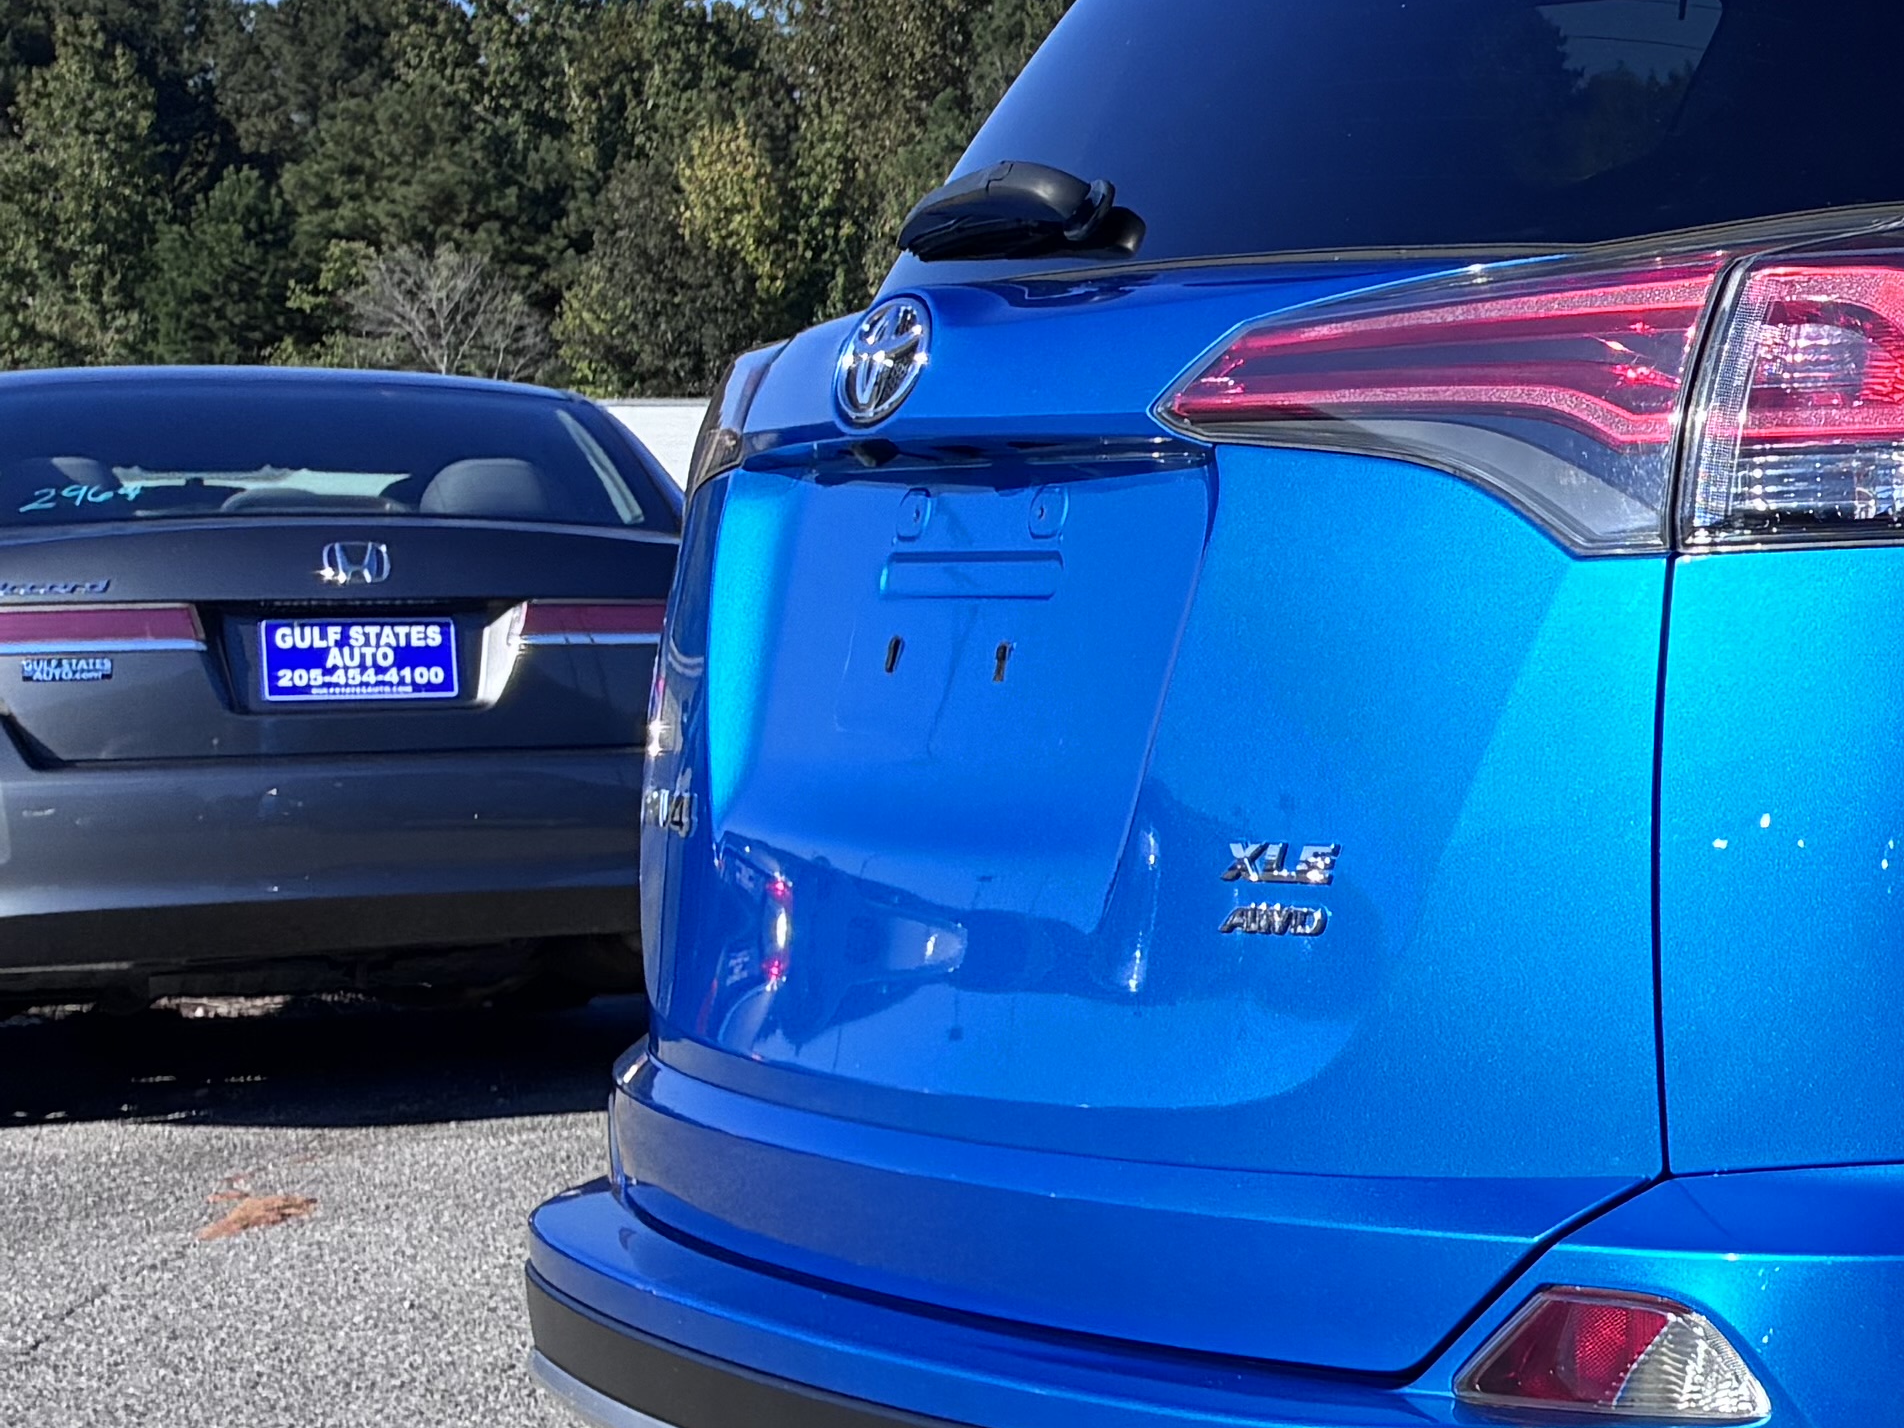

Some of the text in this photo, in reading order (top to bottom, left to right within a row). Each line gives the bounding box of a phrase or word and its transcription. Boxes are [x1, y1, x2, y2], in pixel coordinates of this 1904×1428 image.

[274, 624, 442, 649] GULF STATES
[325, 646, 395, 668] AUTO
[277, 666, 445, 687] 205-454-4100
[1220, 840, 1342, 886] XLE
[1218, 902, 1329, 937] AWD
